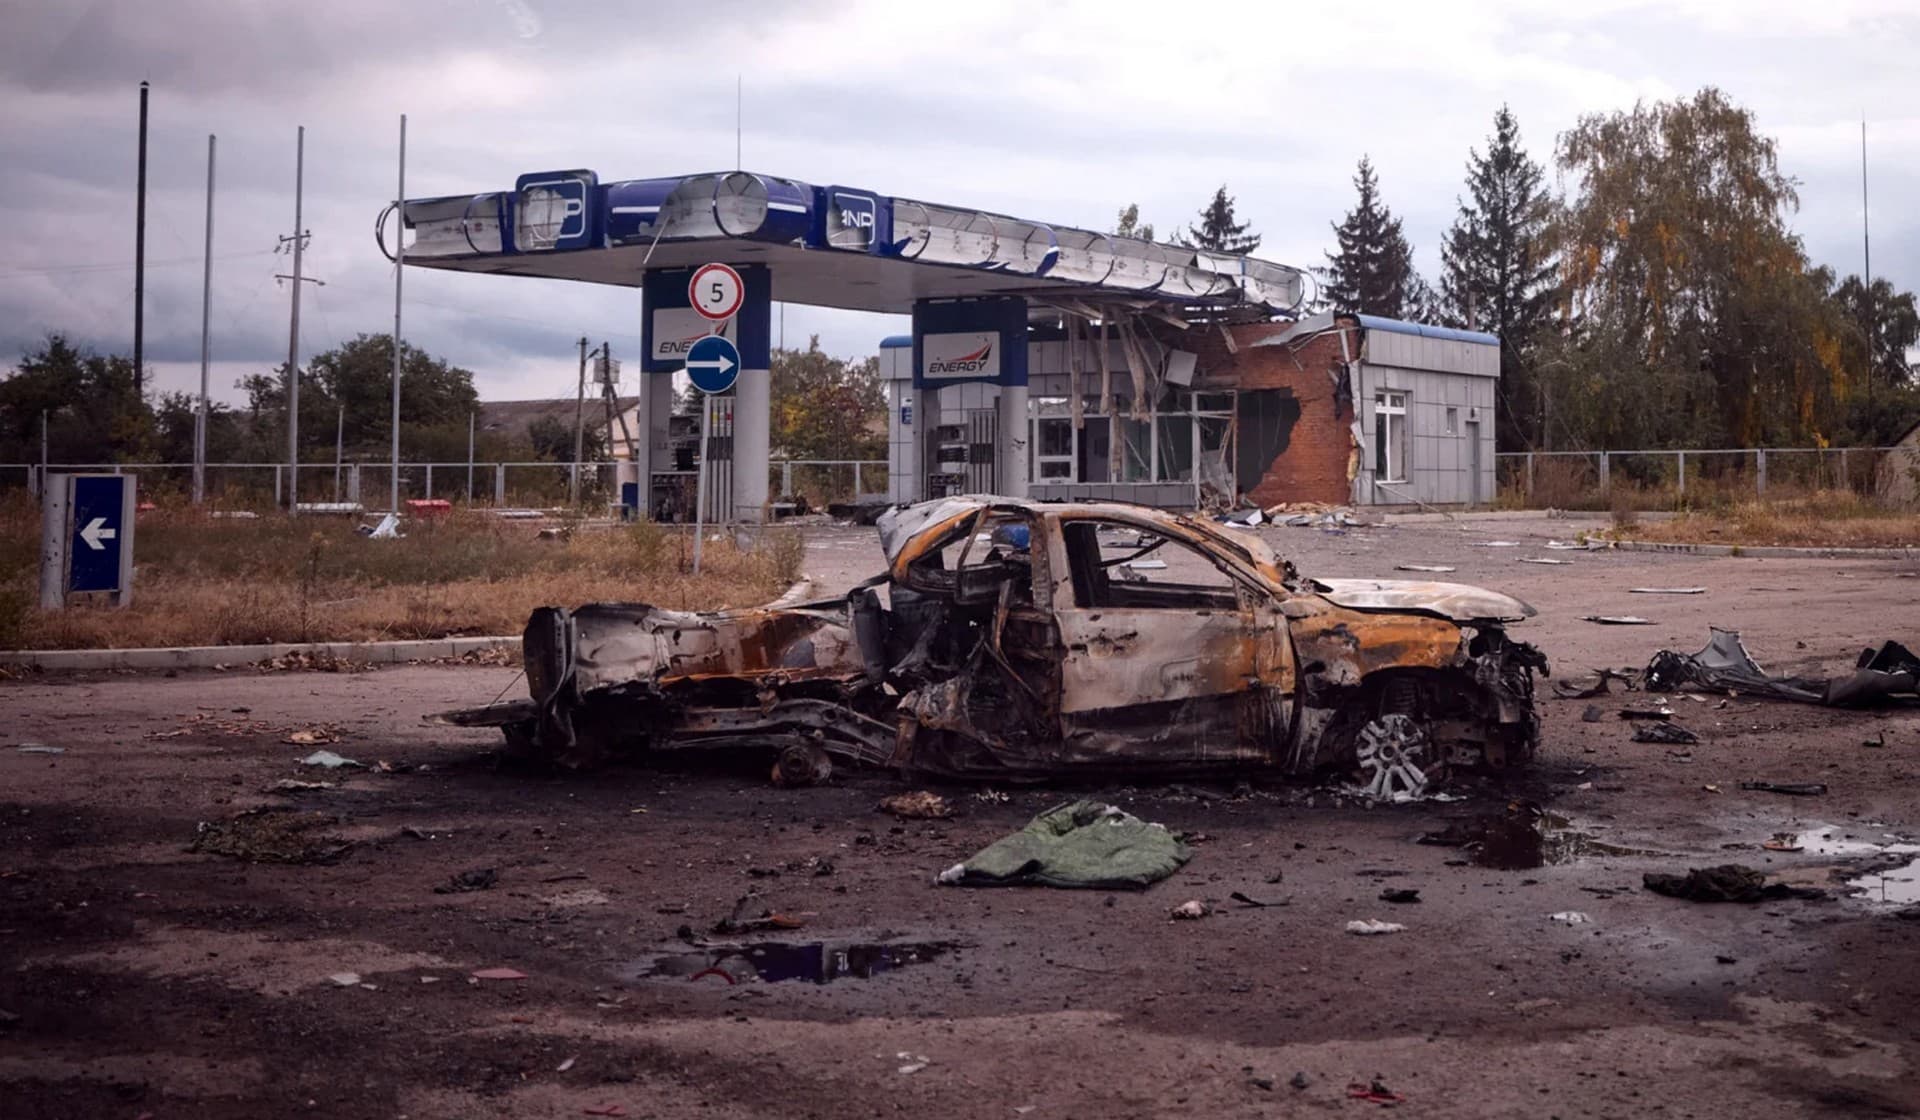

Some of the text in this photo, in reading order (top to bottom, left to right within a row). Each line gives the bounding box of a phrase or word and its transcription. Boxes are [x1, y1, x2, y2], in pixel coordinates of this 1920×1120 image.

[711, 283, 724, 303] 5
[659, 341, 693, 353] ENE
[929, 361, 987, 373] ENERGY
